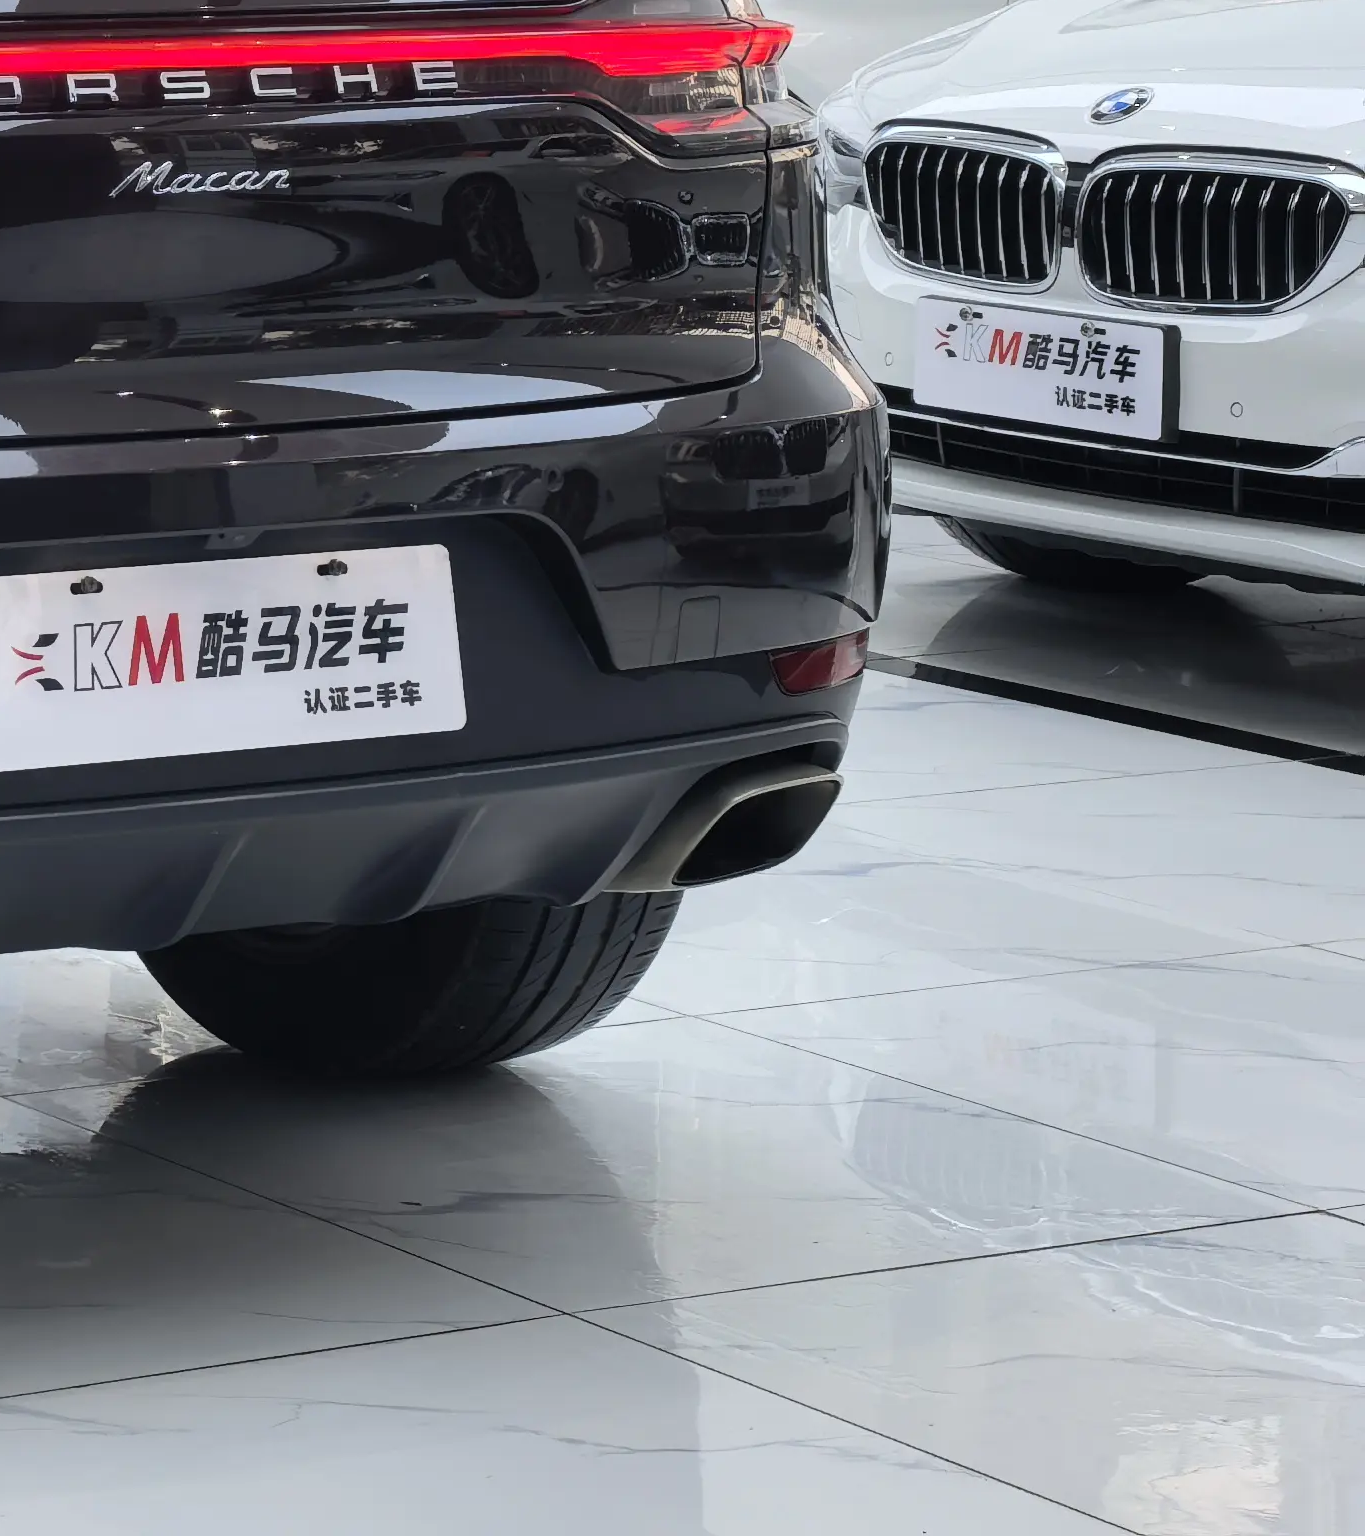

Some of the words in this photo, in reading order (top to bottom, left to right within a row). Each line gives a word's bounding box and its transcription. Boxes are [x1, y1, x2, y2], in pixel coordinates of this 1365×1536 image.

[109, 160, 291, 198] Macan
[1054, 385, 1137, 417] 认证二手车
[303, 679, 423, 715] 认证二手车
